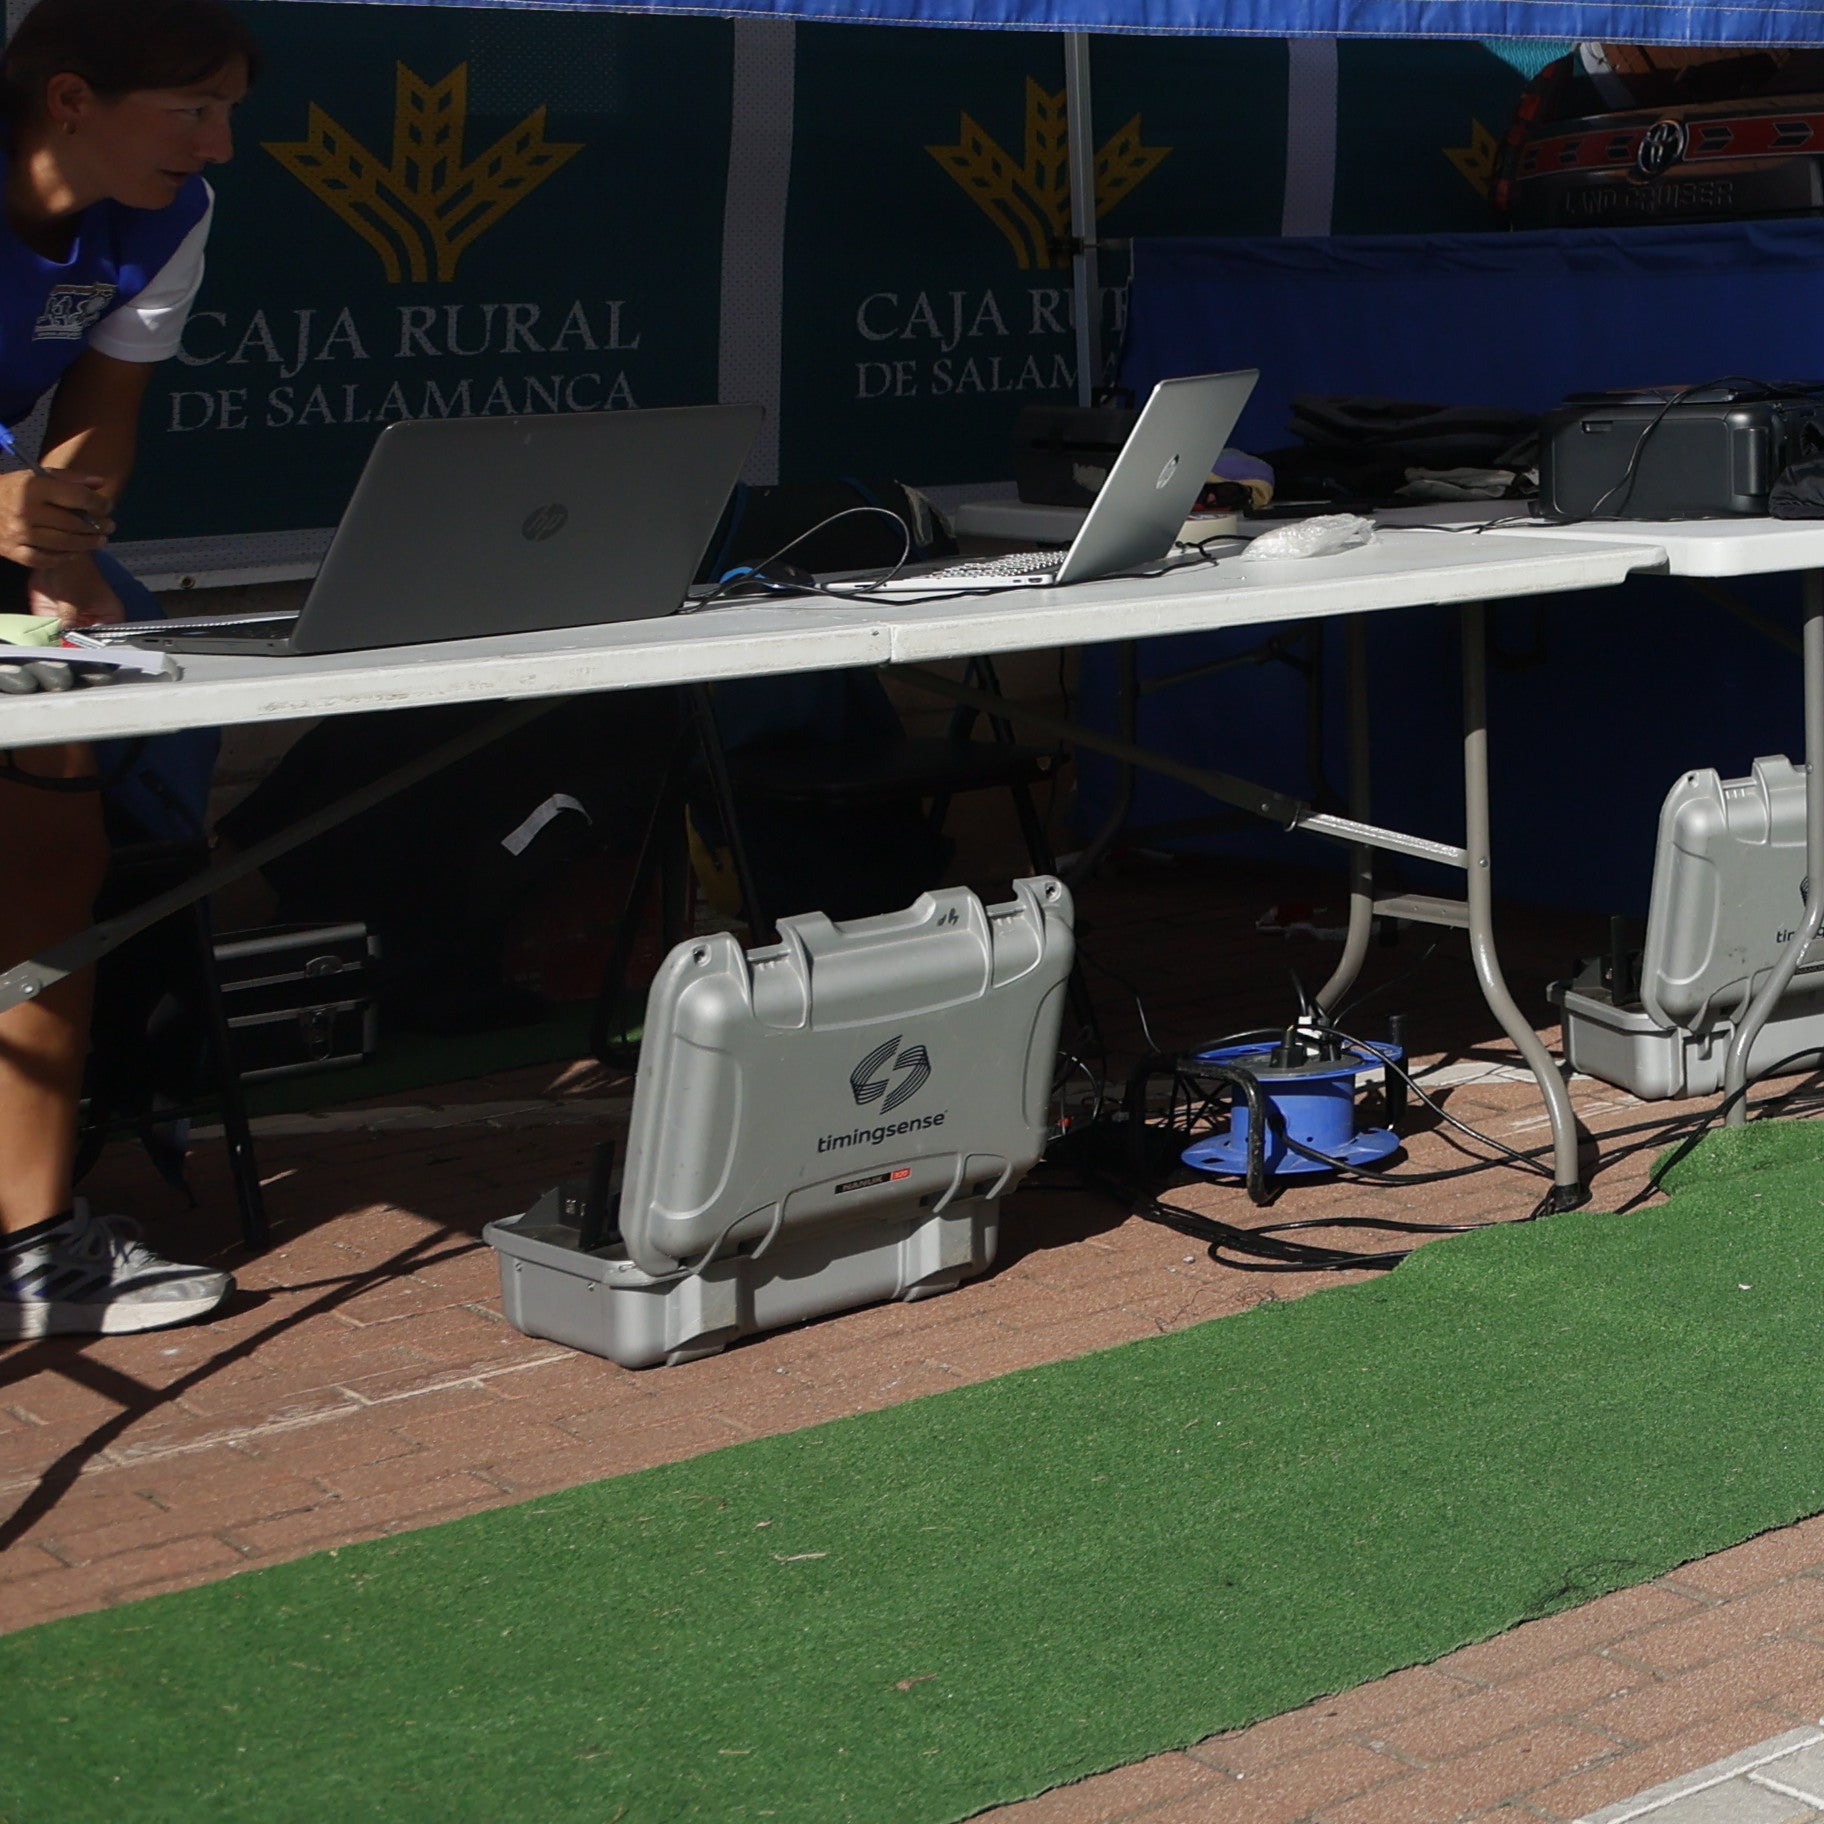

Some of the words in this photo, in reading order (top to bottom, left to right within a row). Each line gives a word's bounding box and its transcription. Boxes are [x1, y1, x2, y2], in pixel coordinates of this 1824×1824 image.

[176, 304, 371, 379] CAJA
[395, 299, 642, 358] RURAL
[856, 288, 1011, 353] CAJA
[166, 387, 249, 433] DE
[265, 370, 642, 429] SALAMANCA
[855, 359, 919, 398] DE
[817, 1112, 945, 1153] timingsense
